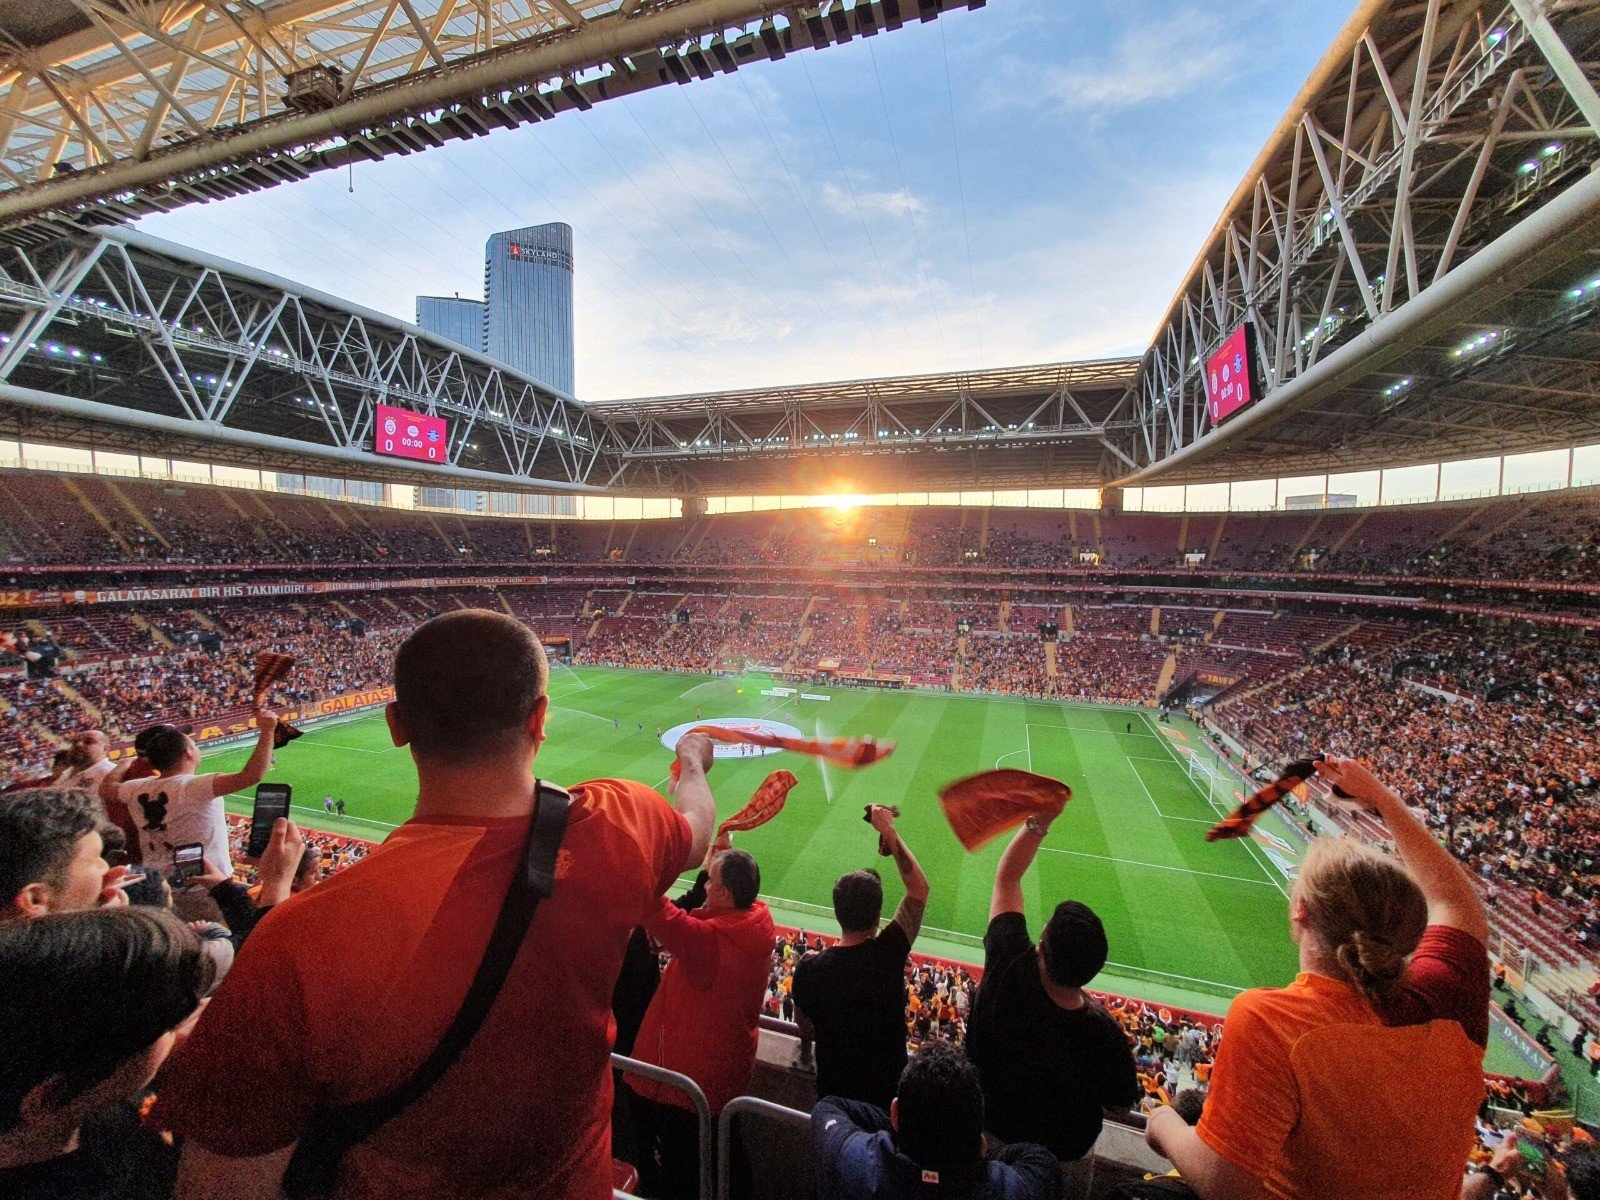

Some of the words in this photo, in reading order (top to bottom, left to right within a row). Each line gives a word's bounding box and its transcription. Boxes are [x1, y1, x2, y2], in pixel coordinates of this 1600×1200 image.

[522, 249, 558, 259] SKYLAND
[385, 439, 393, 452] 0
[402, 437, 423, 448] 00:00
[428, 447, 436, 459] 0
[97, 588, 194, 602] GALATASARAY
[198, 586, 220, 598] BİR
[246, 584, 305, 596] TAKIMIDIR!
[208, 737, 234, 747] DAMAT
[1503, 1026, 1549, 1070] DAMAT
